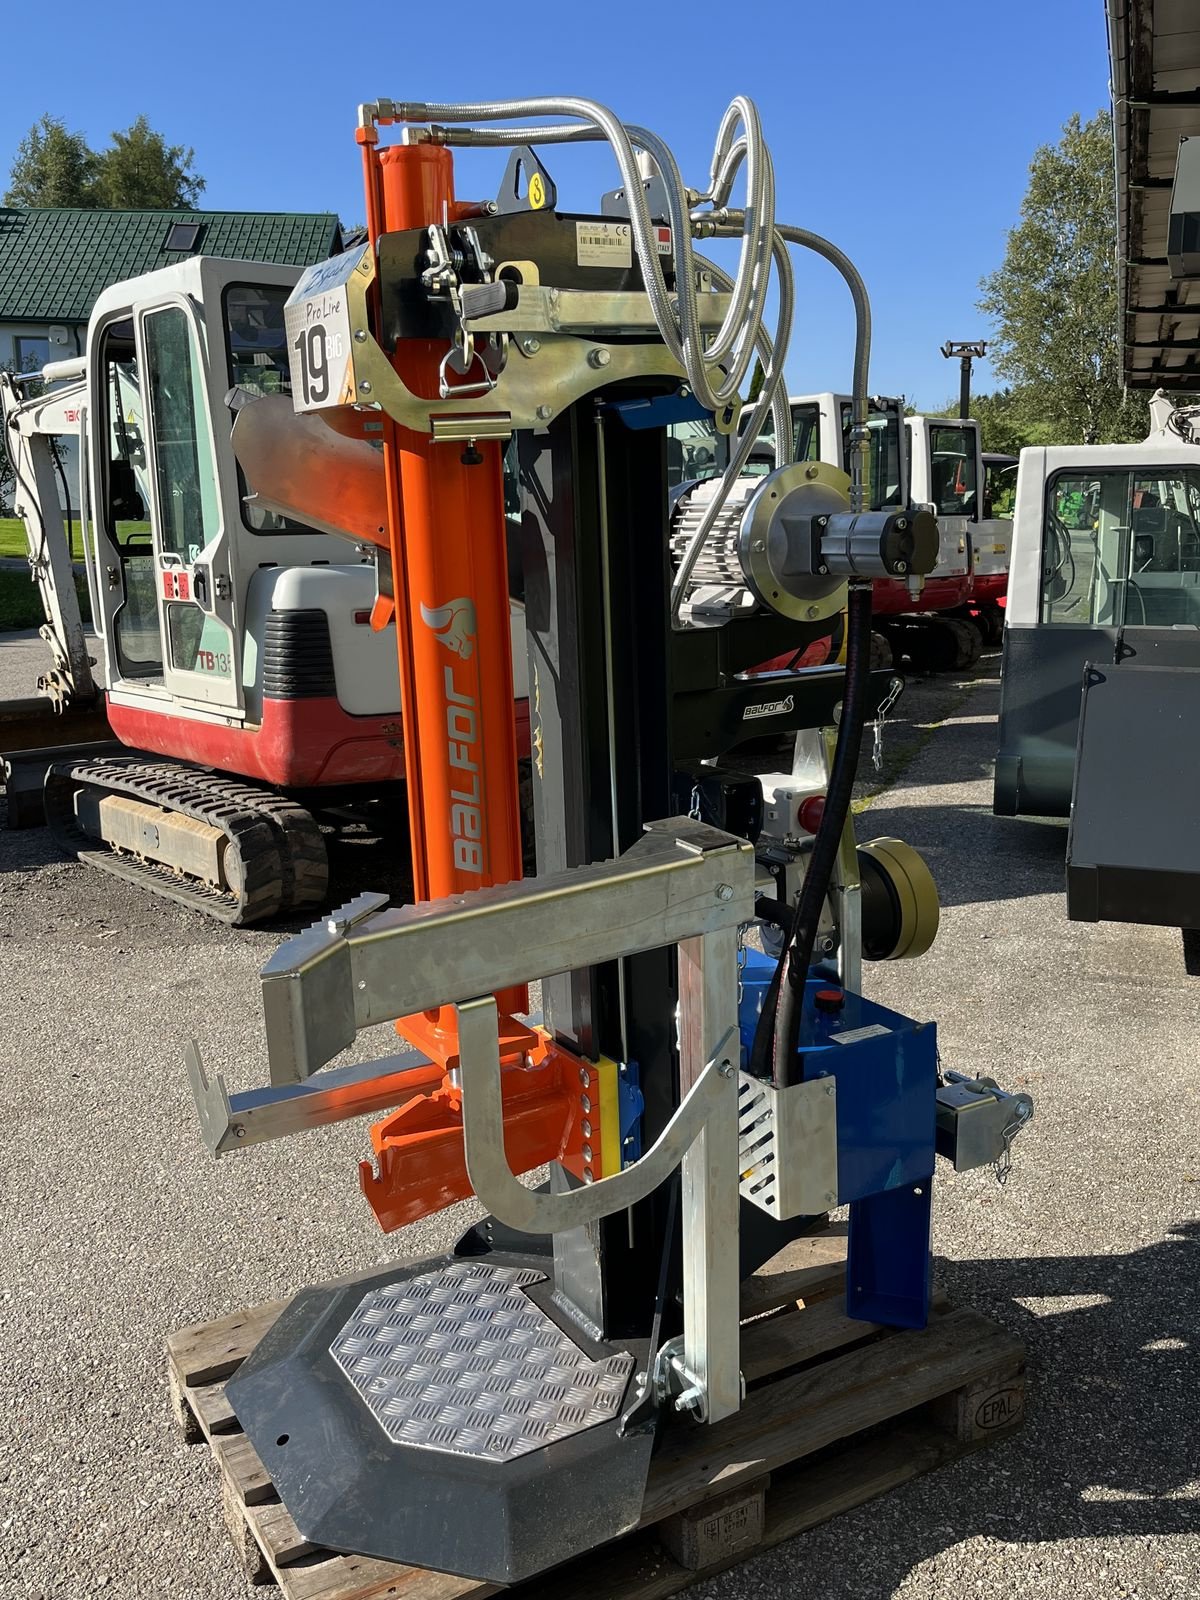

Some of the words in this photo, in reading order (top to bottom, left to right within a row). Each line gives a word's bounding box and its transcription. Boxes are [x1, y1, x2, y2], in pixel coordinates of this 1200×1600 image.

[615, 226, 628, 237] CE
[306, 302, 321, 324] Pro
[325, 333, 342, 361] BIG
[294, 323, 329, 405] 19
[983, 1398, 1016, 1424] EPAL
